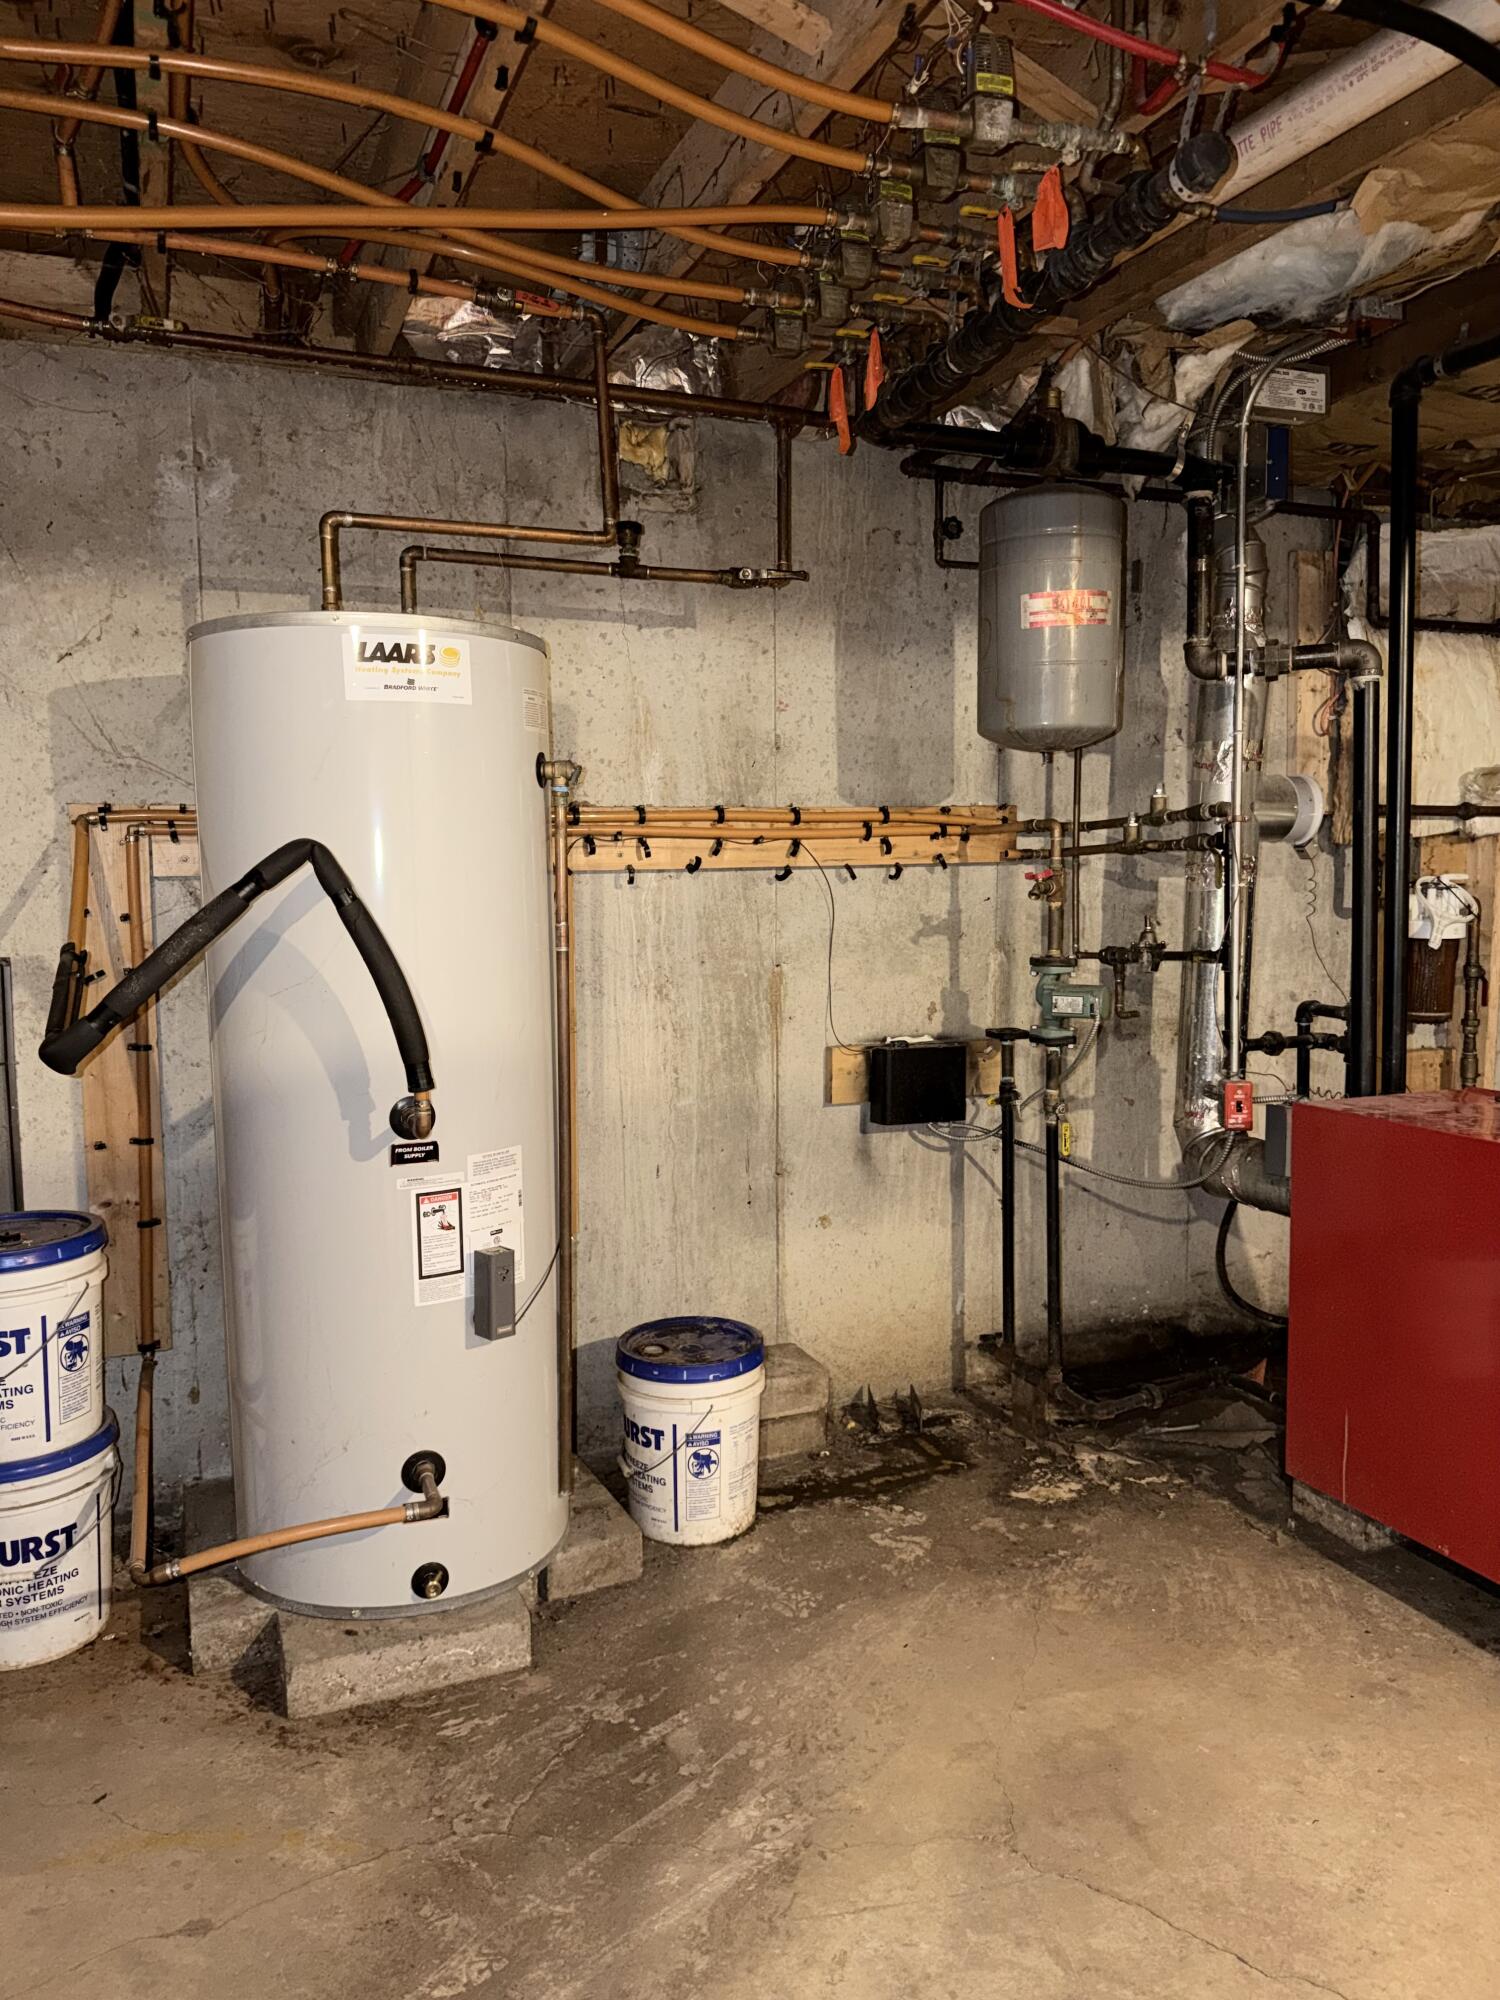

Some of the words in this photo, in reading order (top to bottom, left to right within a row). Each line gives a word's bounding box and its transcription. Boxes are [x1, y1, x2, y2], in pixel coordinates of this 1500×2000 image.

[1260, 115, 1283, 143] PIPE
[358, 641, 436, 665] LAARS
[0, 1384, 34, 1399] TING
[0, 1522, 77, 1568] URST
[28, 1568, 79, 1593] HEATING
[6, 1585, 65, 1608] SYSTEMS
[20, 1599, 64, 1618] NON-TOXIC
[15, 1612, 47, 1626] SYSTEM
[48, 1594, 88, 1618] EFFICIENCY
